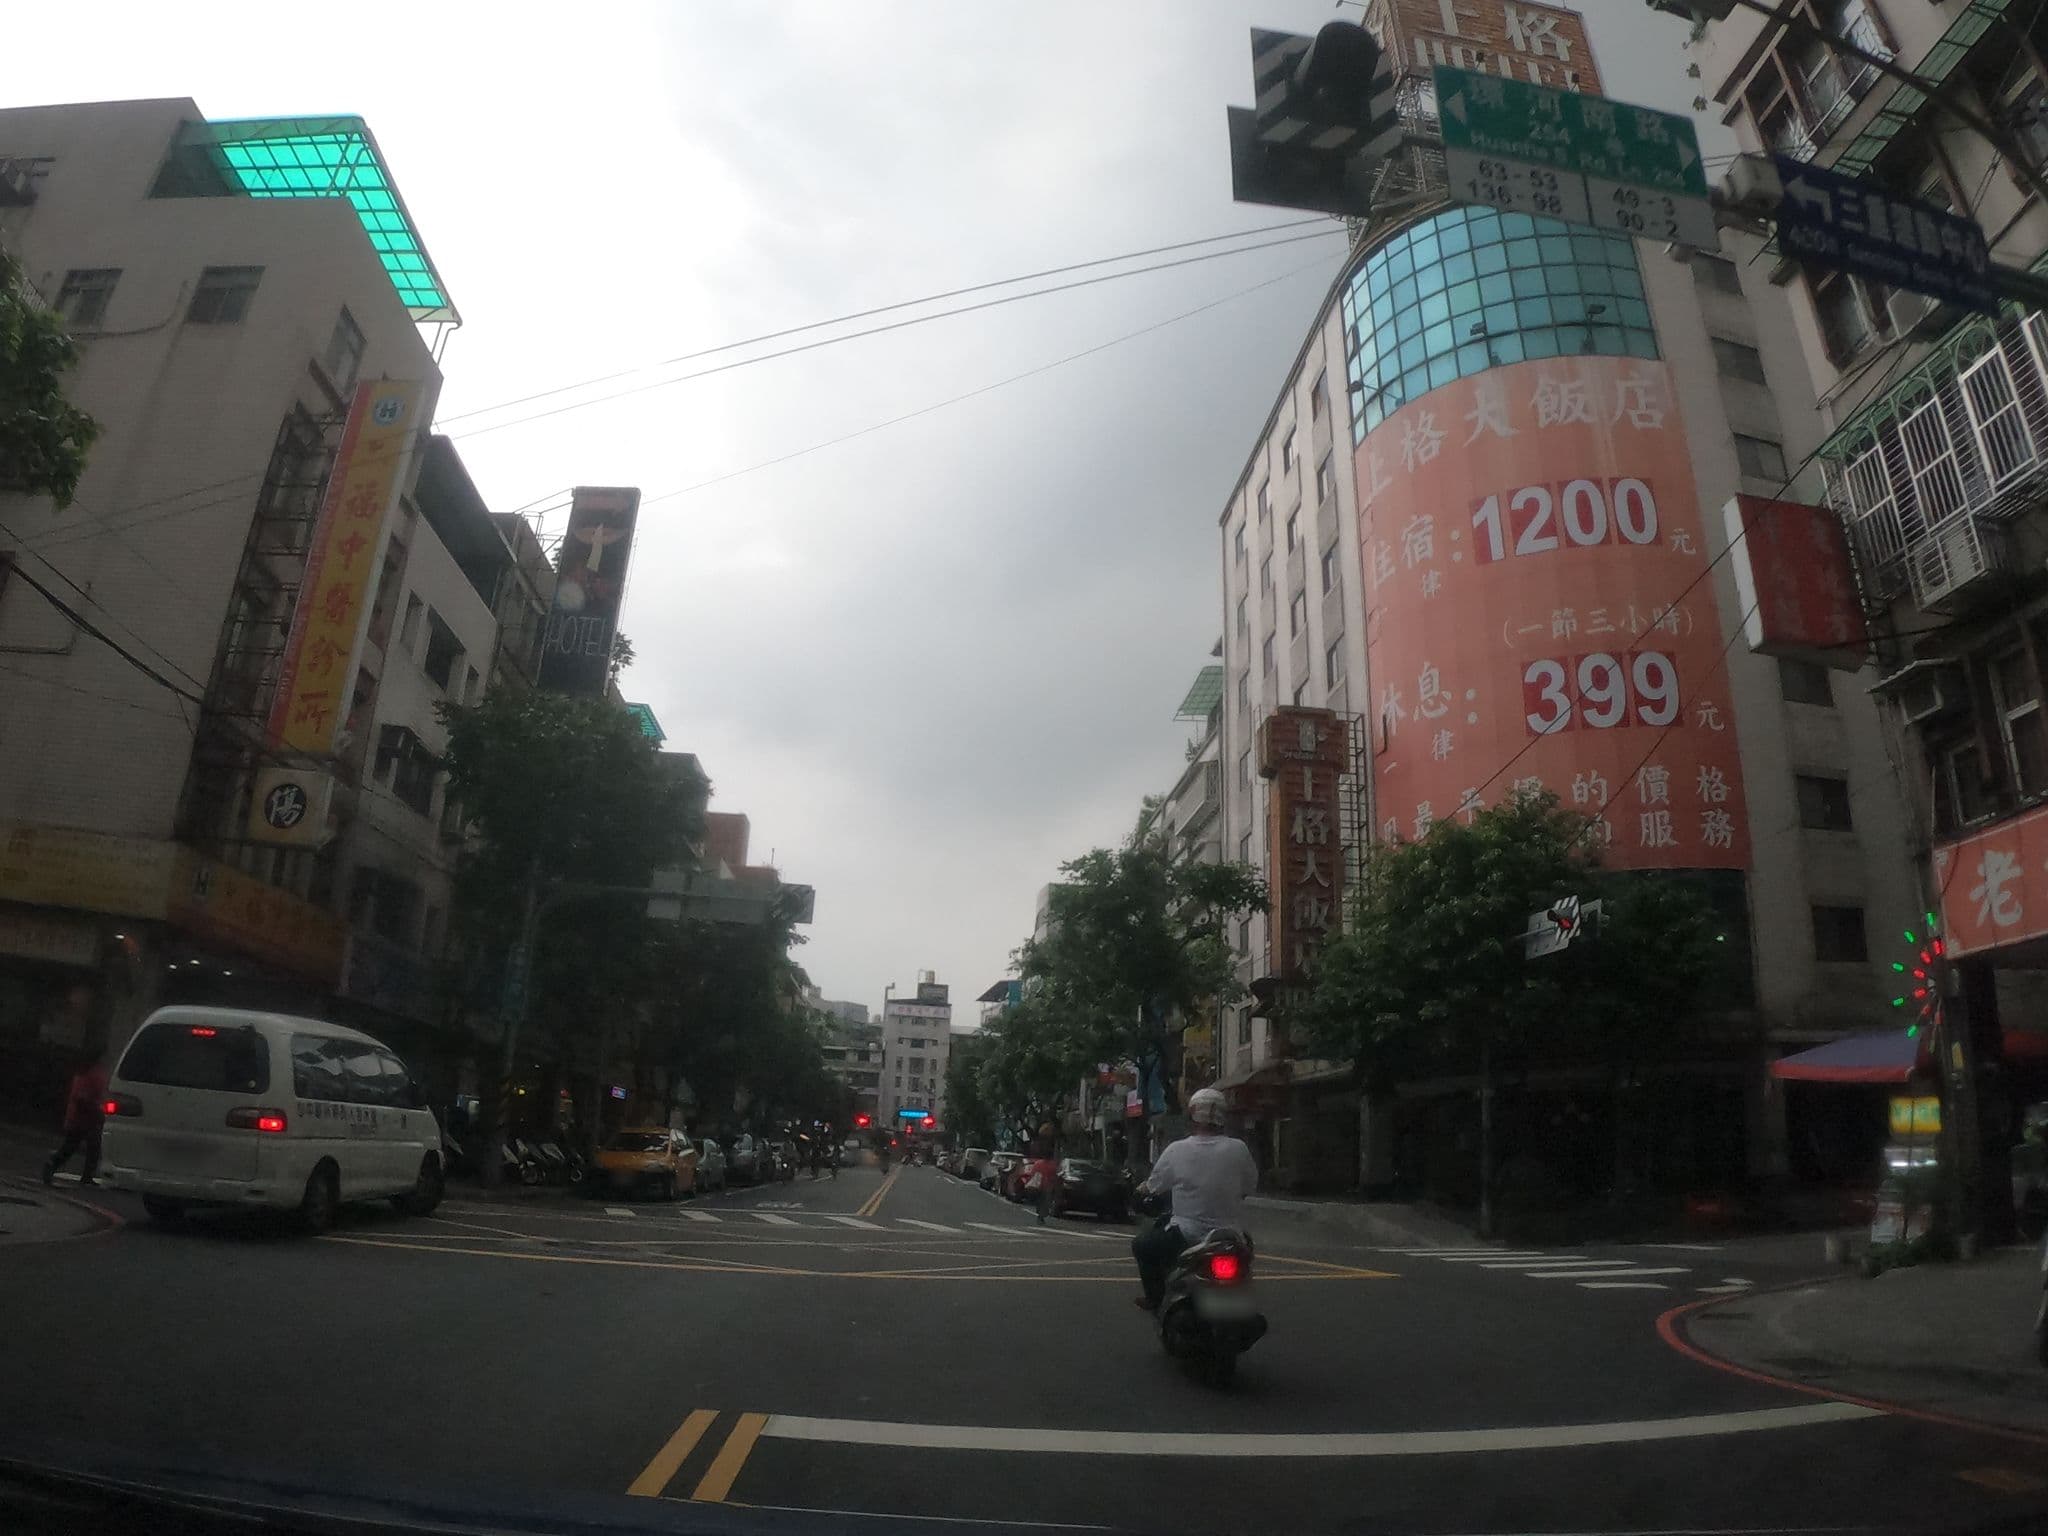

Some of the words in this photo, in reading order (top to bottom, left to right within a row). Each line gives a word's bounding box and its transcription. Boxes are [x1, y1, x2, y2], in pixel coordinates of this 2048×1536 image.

[1361, 373, 1665, 508] 上格大飯店
[1471, 478, 1660, 561] 1200
[1670, 526, 1697, 556] 元
[543, 615, 608, 657] HOTEL
[1523, 650, 1681, 735] 399
[1695, 700, 1727, 732] 元
